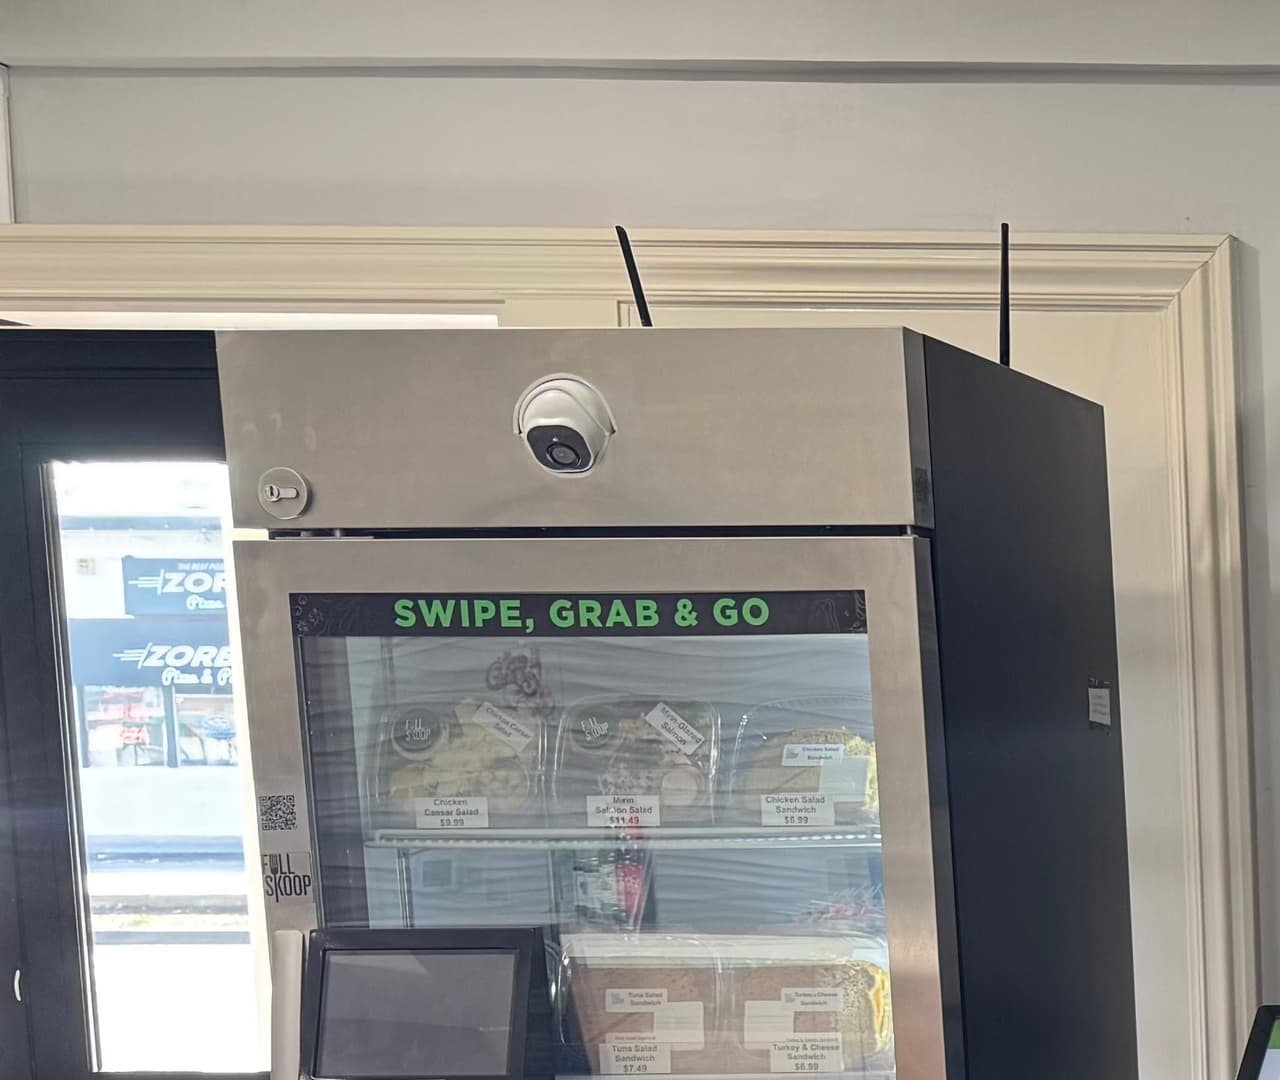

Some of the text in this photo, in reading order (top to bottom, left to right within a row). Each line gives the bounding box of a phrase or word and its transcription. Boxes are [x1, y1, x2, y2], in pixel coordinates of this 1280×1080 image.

[393, 597, 770, 633] SWIPE, GRAB & GO
